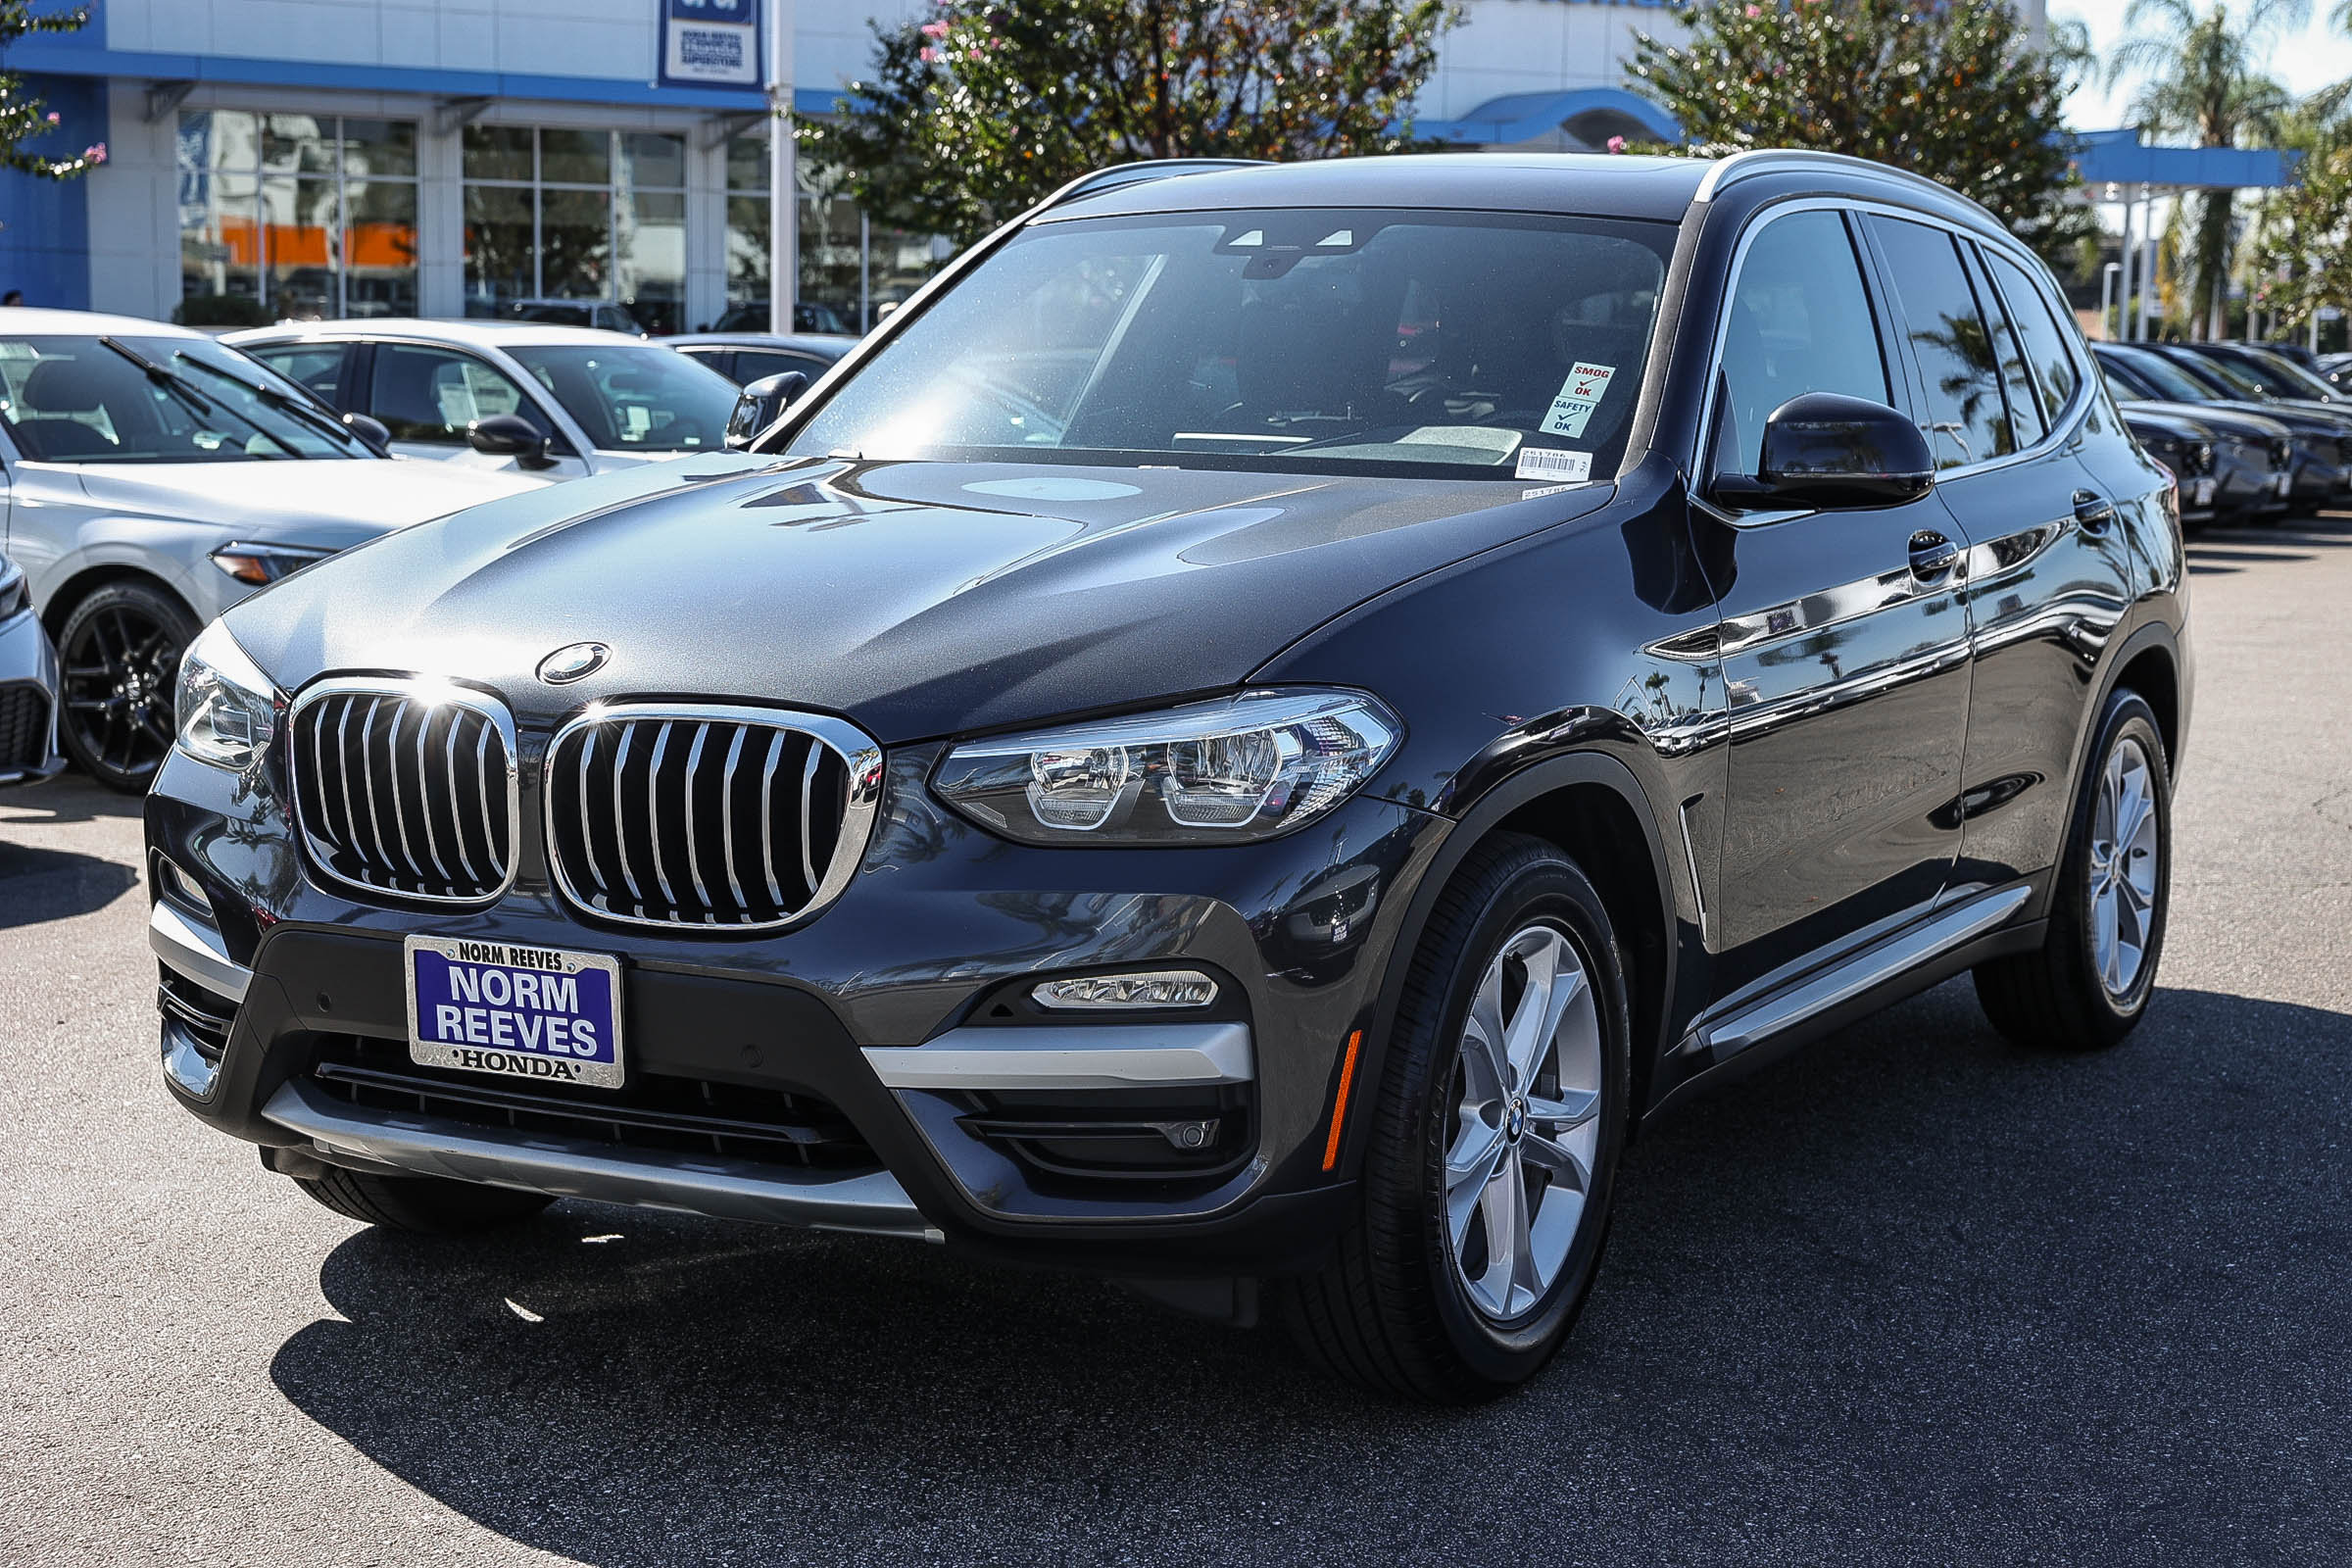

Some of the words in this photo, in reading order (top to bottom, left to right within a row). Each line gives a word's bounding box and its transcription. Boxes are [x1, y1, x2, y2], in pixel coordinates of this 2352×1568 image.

[1574, 367, 1609, 378] SMOG
[1575, 387, 1592, 396] OK
[1554, 401, 1592, 413] SAFETY
[1554, 422, 1571, 431] OK
[459, 942, 506, 965] NORM
[509, 948, 563, 971] REEVES
[448, 965, 579, 1014] NORM
[436, 1004, 598, 1057] REEVES
[460, 1049, 576, 1081] HONDA
